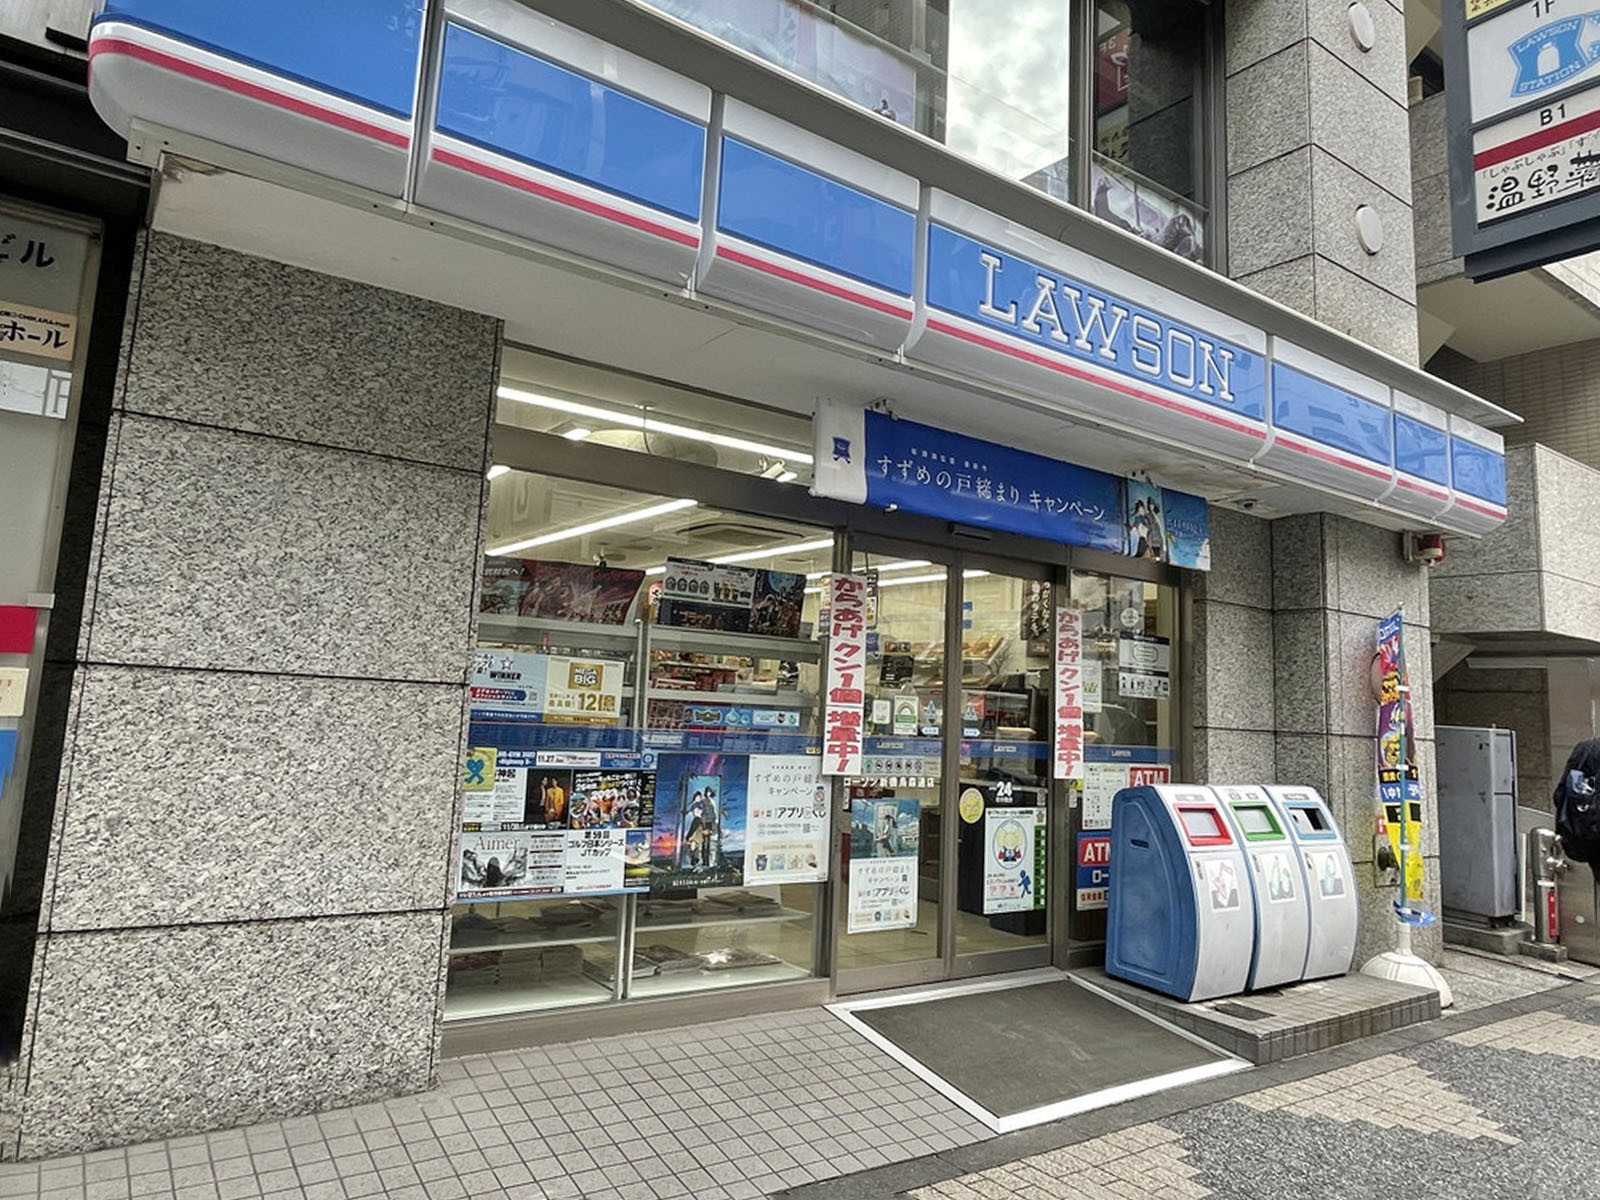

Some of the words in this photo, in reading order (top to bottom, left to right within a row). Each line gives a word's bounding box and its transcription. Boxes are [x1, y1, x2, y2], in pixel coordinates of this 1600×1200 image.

[1516, 19, 1579, 53] LAWSON
[1518, 60, 1582, 92] STATION
[1540, 103, 1567, 127] B1
[979, 251, 1235, 403] LAWSON
[876, 455, 1020, 507] すずめの戸締まり
[1029, 489, 1106, 522] キャンペーン
[573, 674, 598, 685] BIG
[473, 835, 521, 851] Aimer
[1083, 842, 1111, 863] AT
